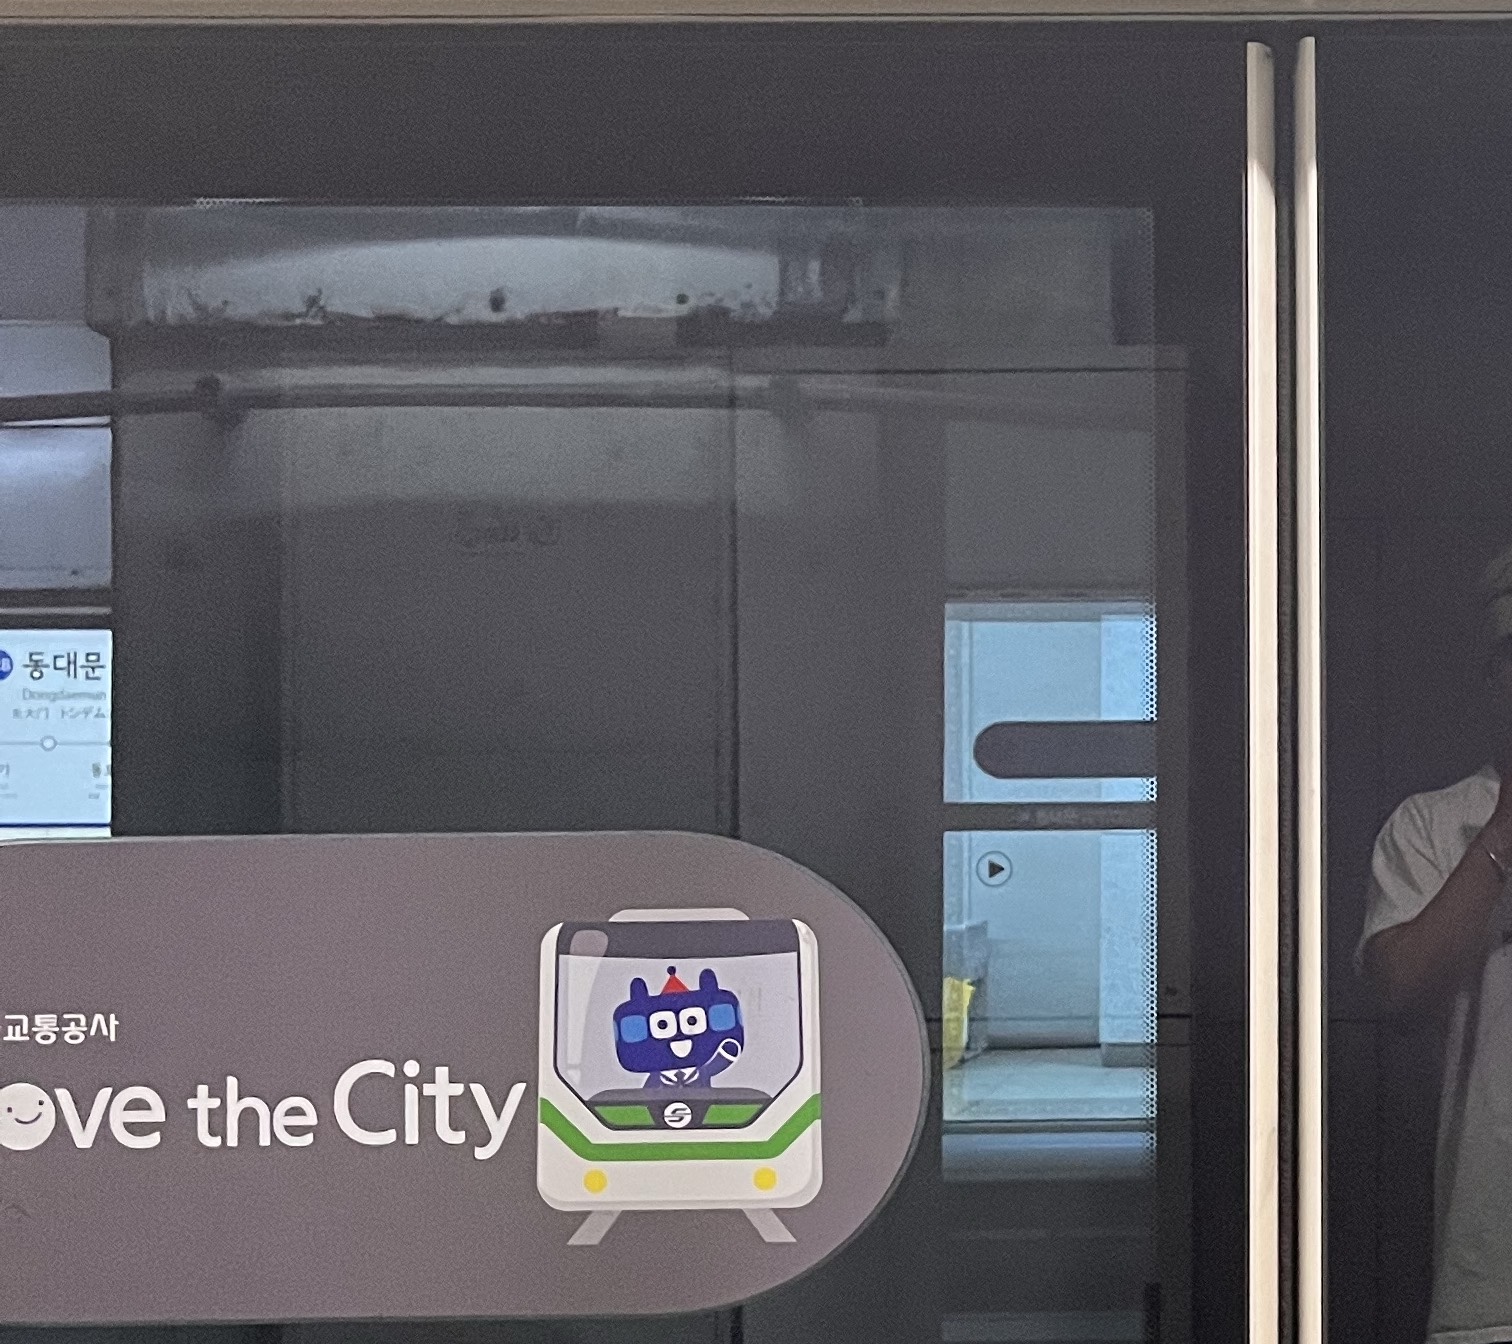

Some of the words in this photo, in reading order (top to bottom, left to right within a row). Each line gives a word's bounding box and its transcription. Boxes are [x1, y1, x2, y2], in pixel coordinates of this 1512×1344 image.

[22, 651, 107, 681] 동대문
[0, 1013, 119, 1045] 교통공사
[186, 1075, 319, 1148] the
[333, 1058, 527, 1161] City
